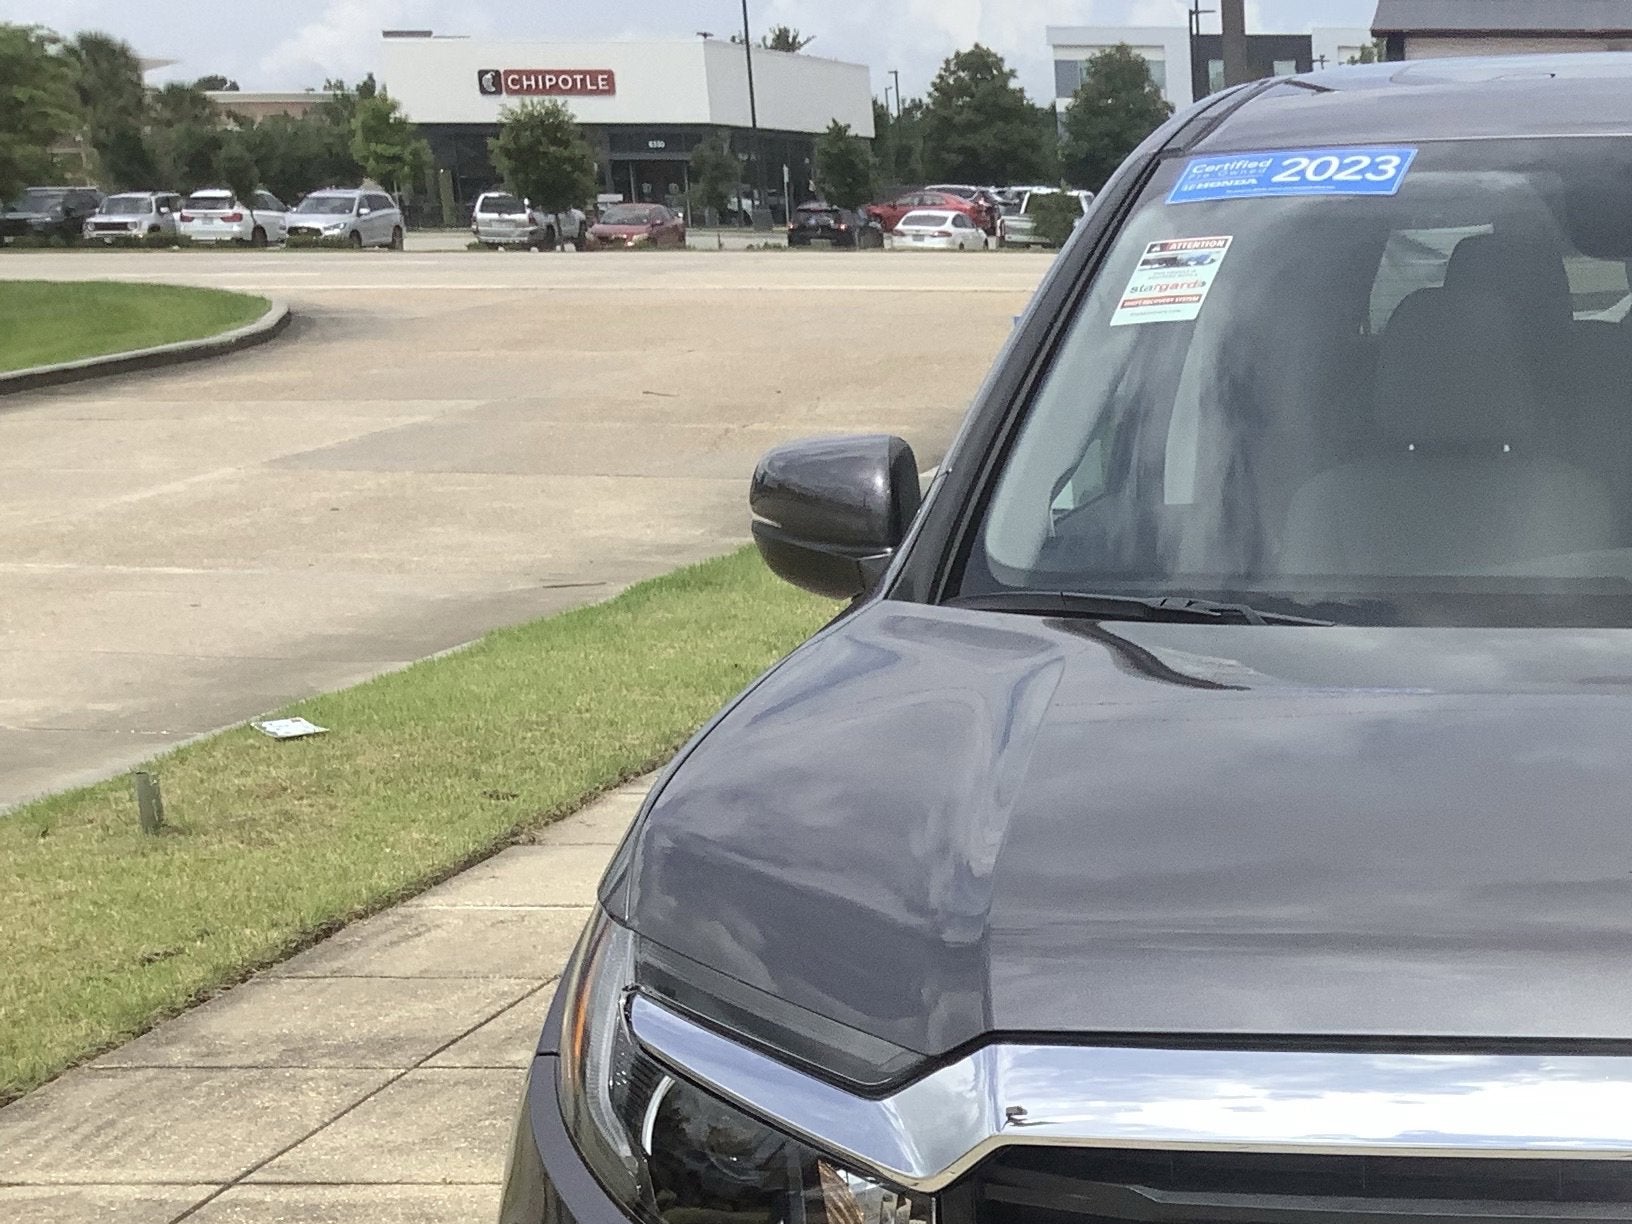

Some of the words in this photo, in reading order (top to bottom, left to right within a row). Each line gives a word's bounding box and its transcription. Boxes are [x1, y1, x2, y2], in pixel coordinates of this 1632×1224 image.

[507, 74, 609, 90] CHIPOTLE
[1192, 158, 1273, 175] Certified
[1271, 155, 1401, 182] 2023
[1197, 178, 1258, 190] HONDA
[1169, 239, 1226, 251] ATTENTION
